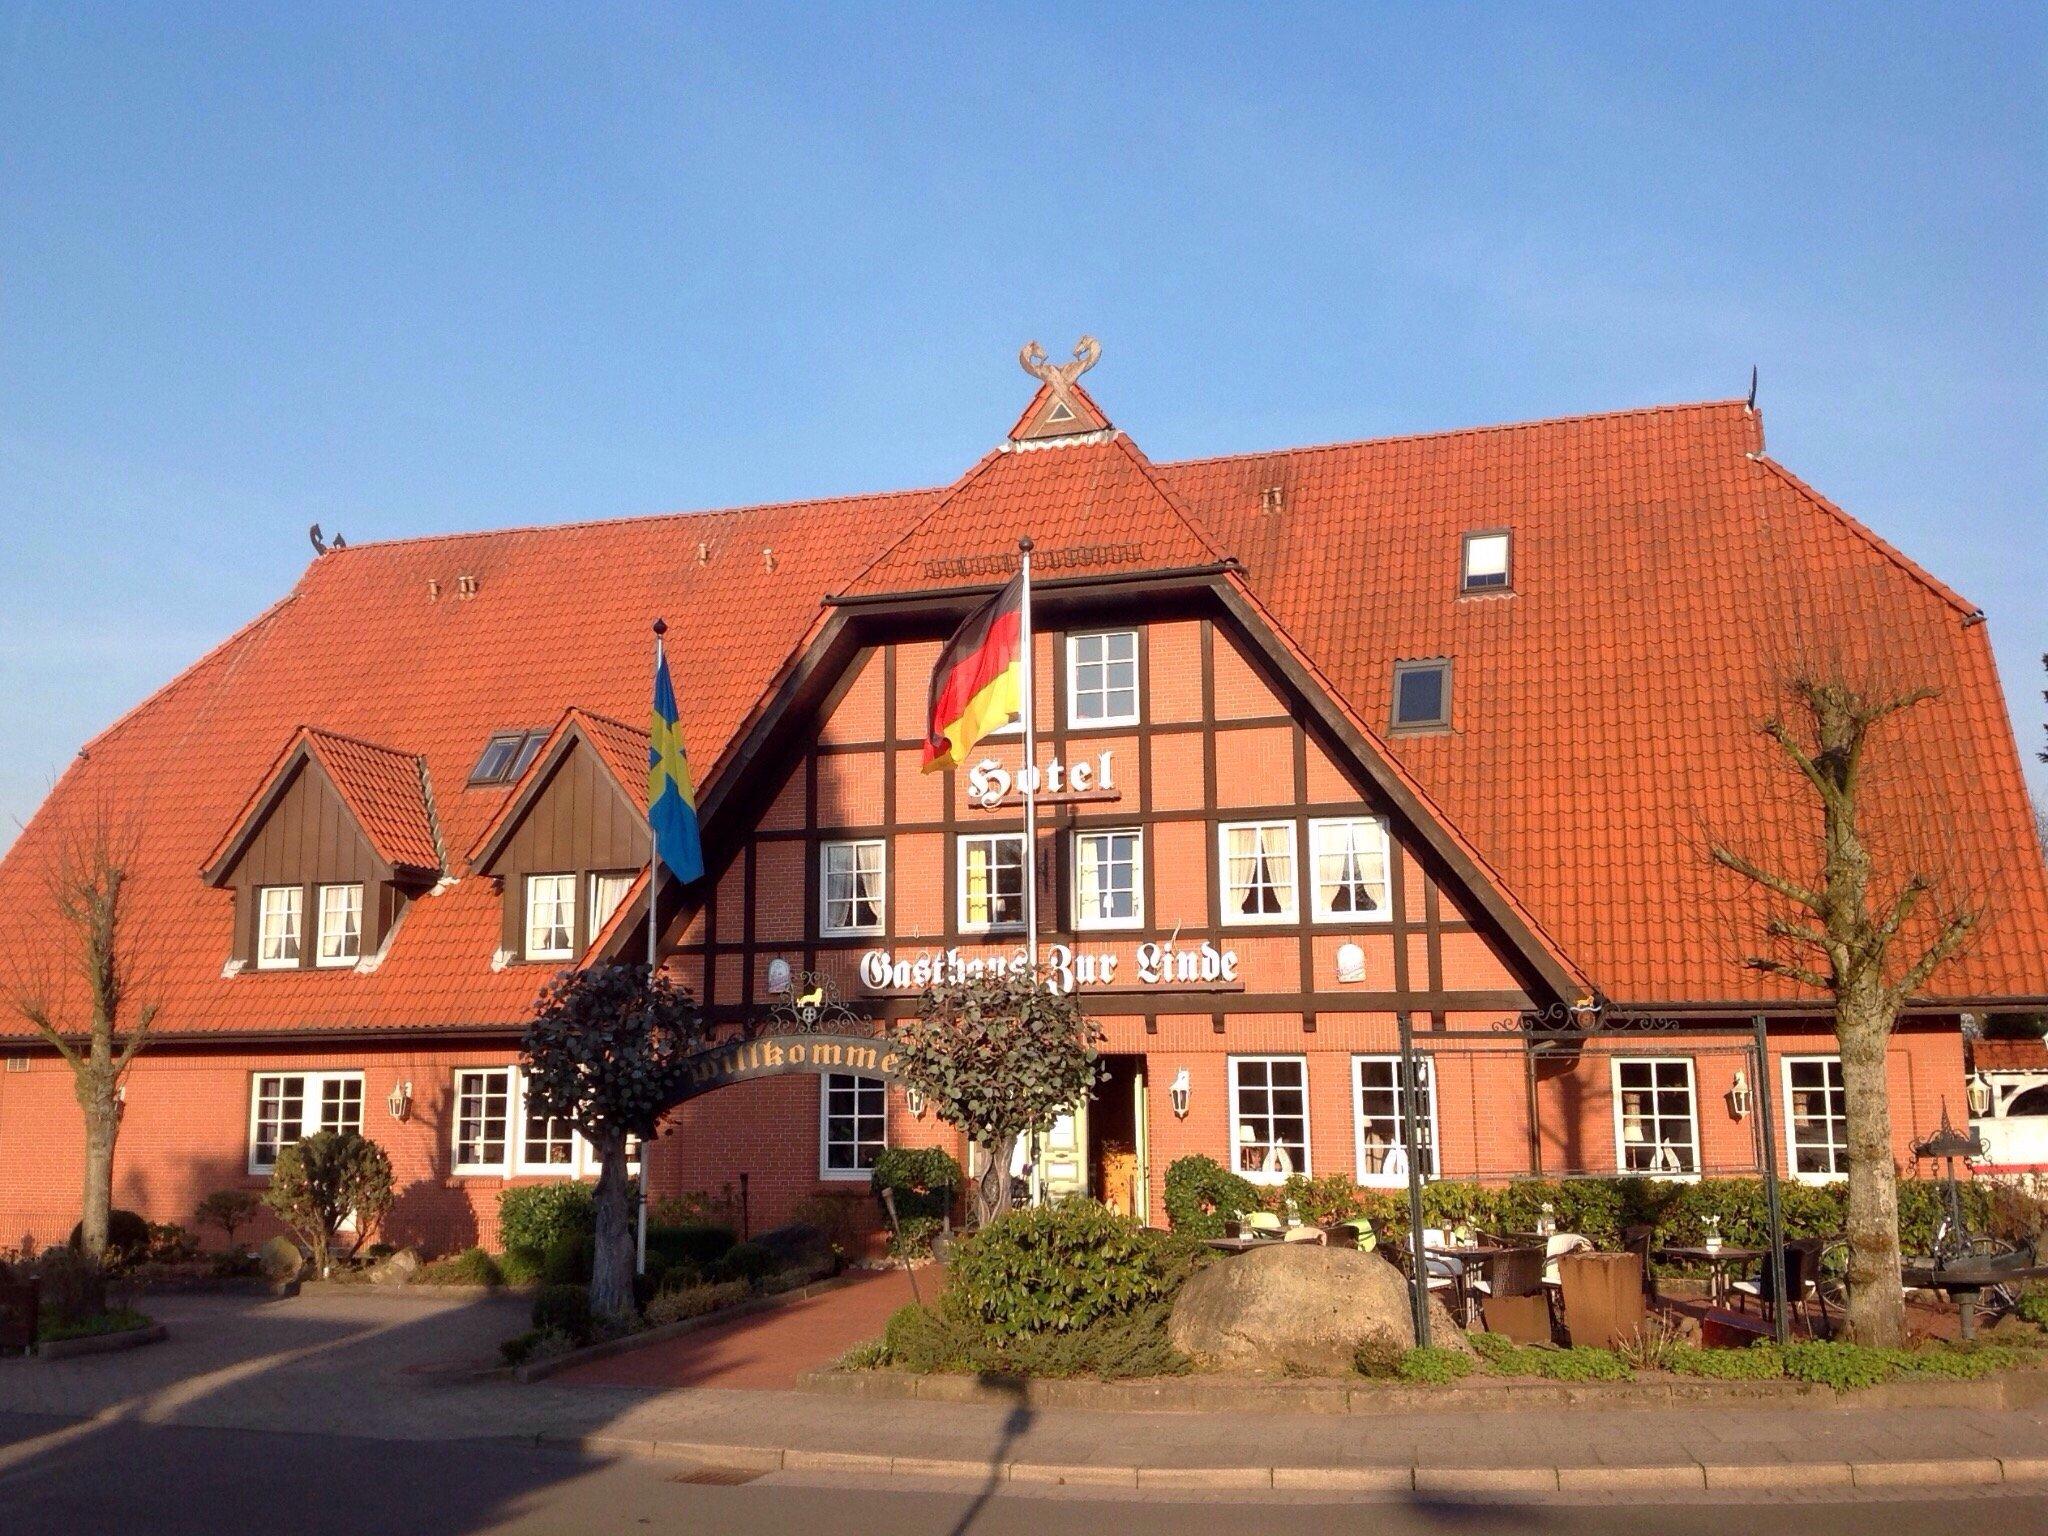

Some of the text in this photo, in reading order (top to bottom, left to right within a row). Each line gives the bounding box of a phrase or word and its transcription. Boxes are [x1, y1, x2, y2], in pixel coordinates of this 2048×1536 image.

[968, 751, 1115, 808] Hotel
[1045, 944, 1118, 996] Zur
[1136, 941, 1239, 984] Linde
